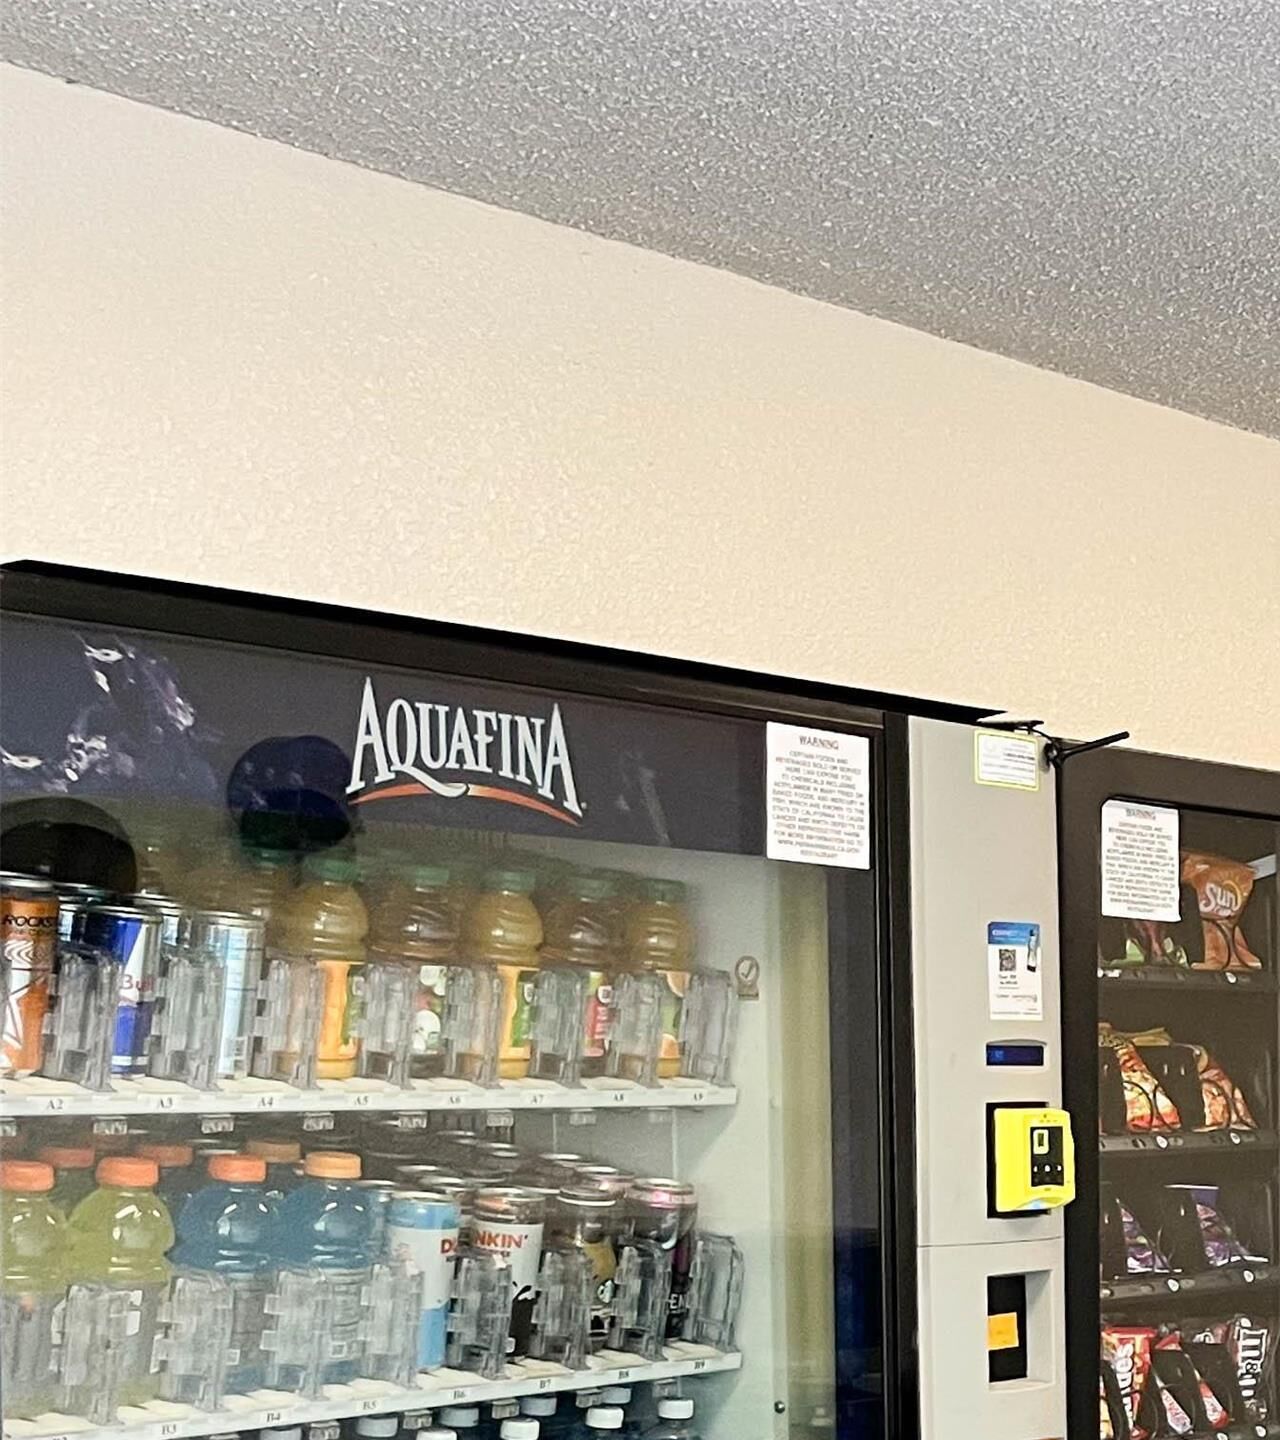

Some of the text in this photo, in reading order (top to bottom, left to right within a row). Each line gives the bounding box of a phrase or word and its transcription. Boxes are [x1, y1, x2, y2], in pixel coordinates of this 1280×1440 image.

[346, 676, 584, 818] AQUAFINA
[46, 1100, 63, 1109] A2
[257, 1097, 273, 1107] A4
